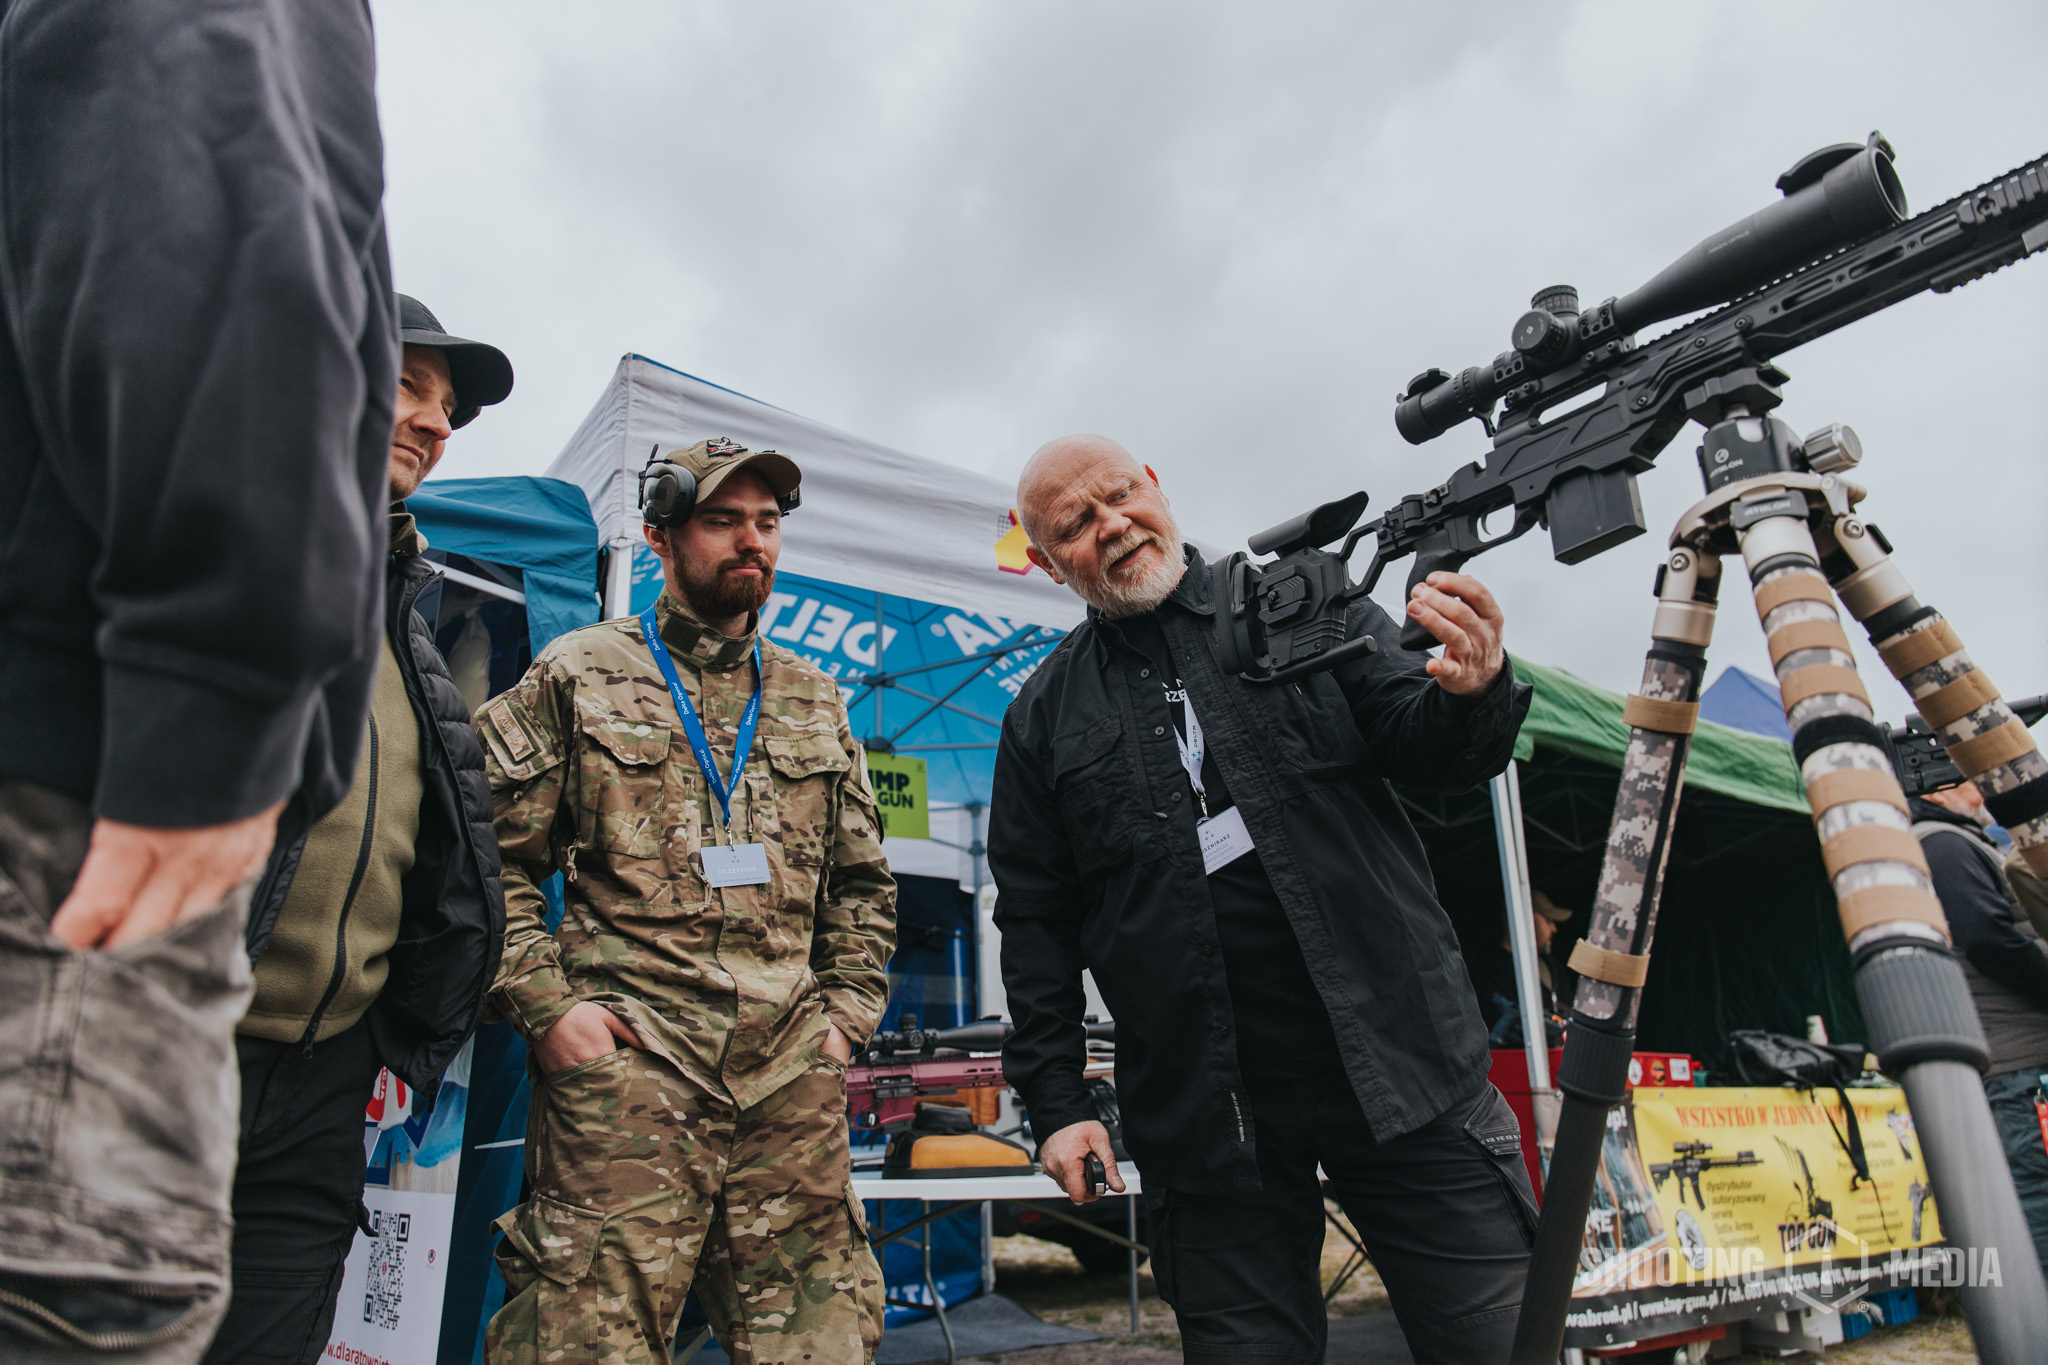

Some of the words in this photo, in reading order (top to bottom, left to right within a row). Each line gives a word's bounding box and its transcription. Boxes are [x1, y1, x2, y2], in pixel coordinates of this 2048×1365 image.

[680, 698, 690, 714] Delta
[699, 749, 711, 770] Optical
[878, 791, 914, 809] GUN
[1676, 1105, 1755, 1128] WSZYSTKO
[1756, 1105, 1767, 1126] W
[1778, 1222, 1806, 1254] TOP
[1807, 1218, 1838, 1250] GUN
